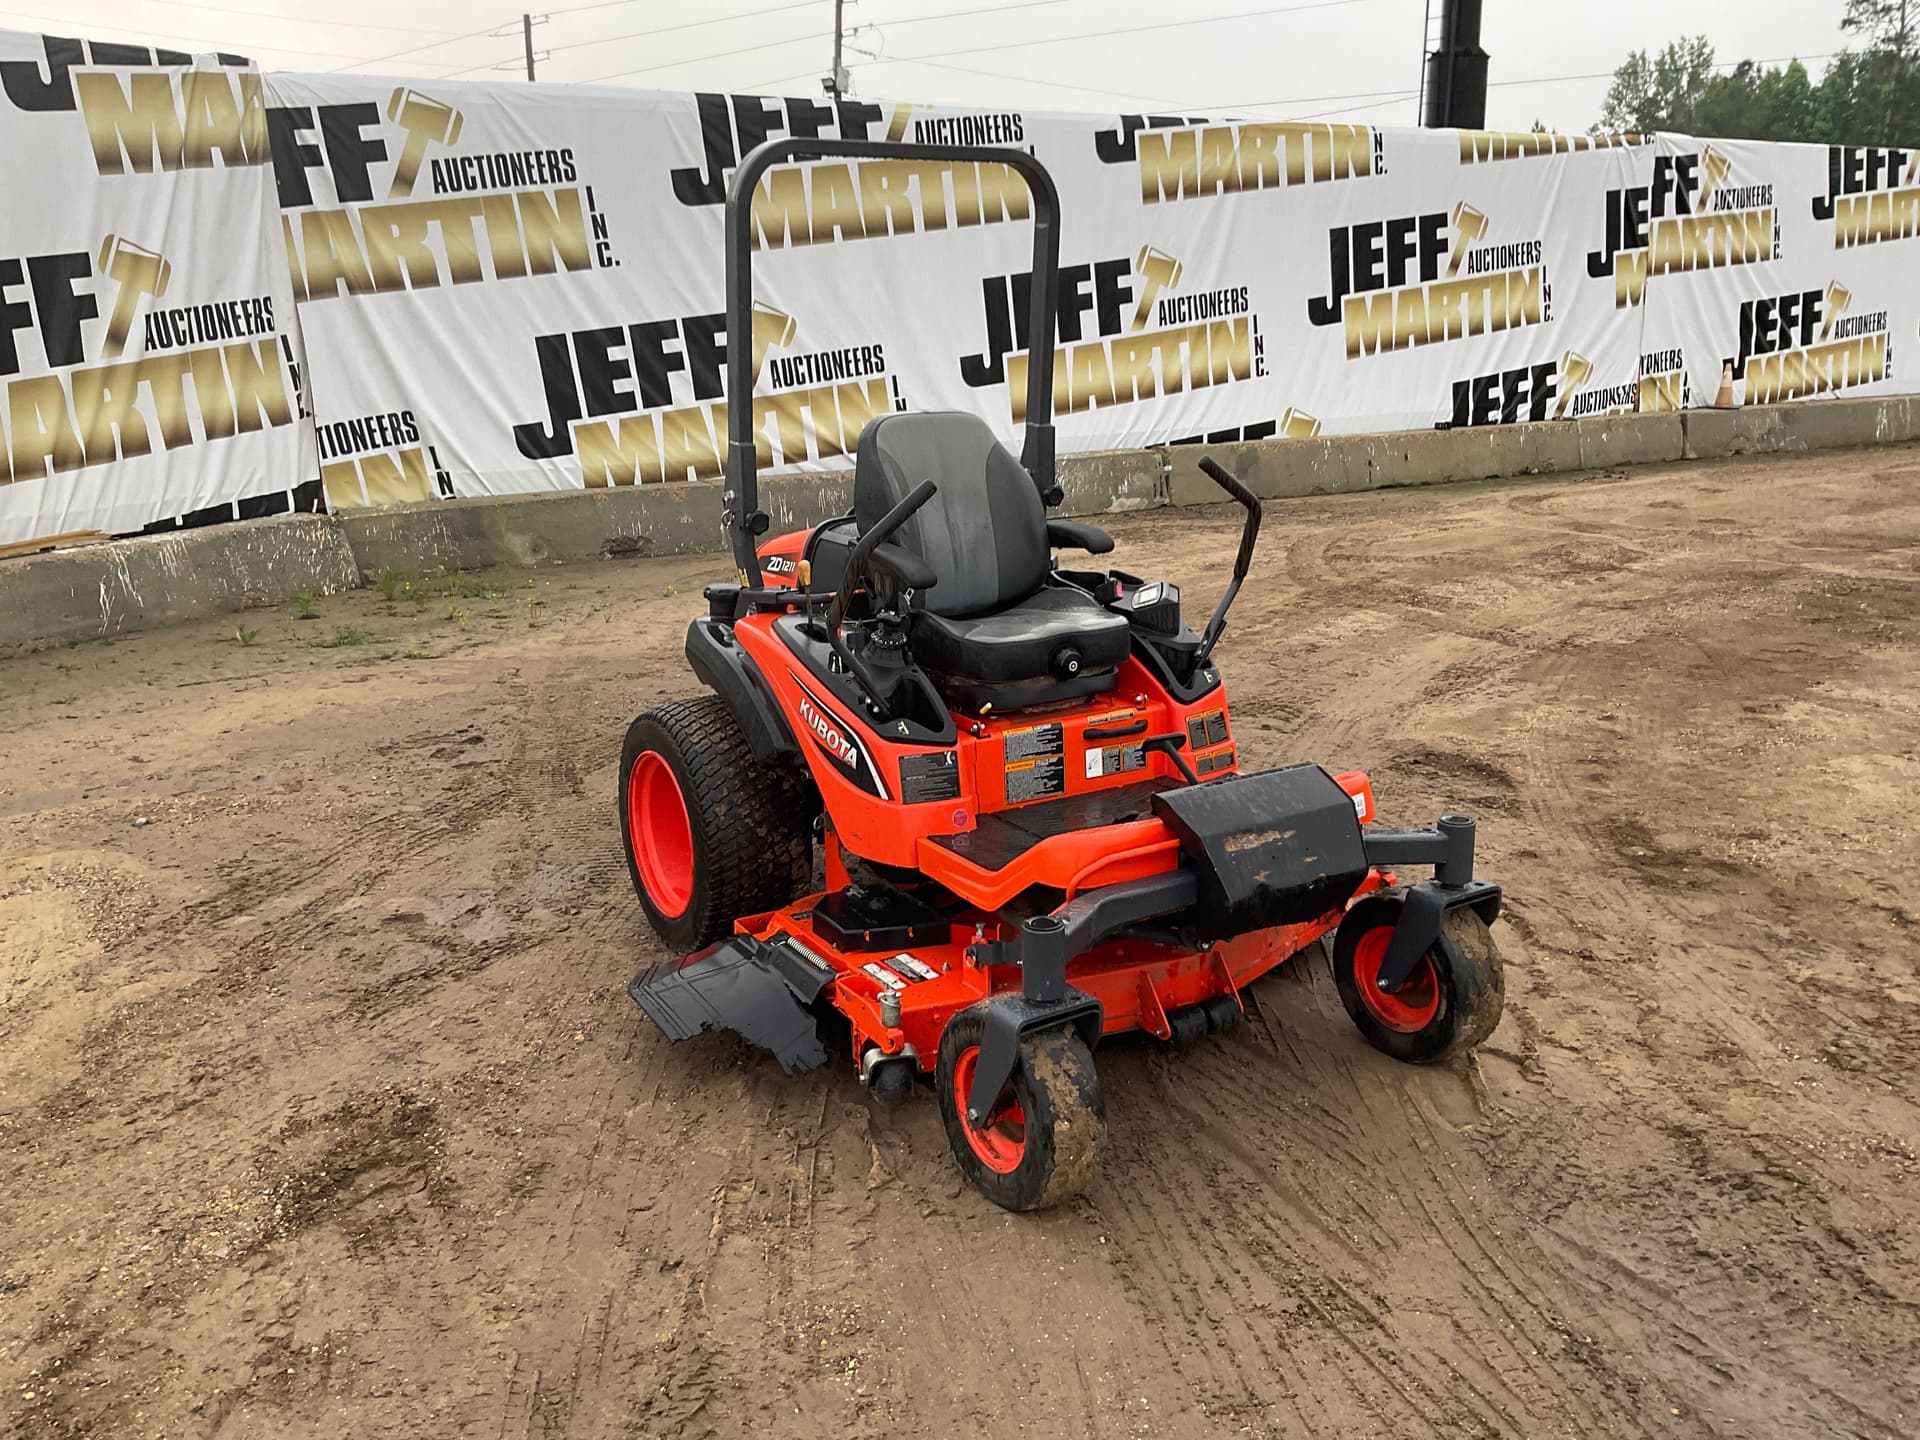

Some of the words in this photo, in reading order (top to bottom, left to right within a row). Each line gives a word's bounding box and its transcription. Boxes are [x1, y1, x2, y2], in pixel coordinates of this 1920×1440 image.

[431, 149, 578, 194] AUCTIONEERS
[1138, 122, 1371, 205] MARTIN
[1714, 184, 1773, 211] AUCTIONEERS
[585, 185, 621, 268] INC.
[1587, 153, 1699, 278] JEFF
[1773, 207, 1783, 260] INC.
[1307, 212, 1449, 326] JEFF
[1467, 240, 1542, 275] AUCTIONEERS
[1542, 265, 1554, 322] INC.
[1616, 209, 1772, 310] MARTIN
[145, 297, 275, 351] AUCTIONEERS
[1159, 286, 1249, 327] AUCTIONEERS
[1343, 267, 1541, 361] MARTIN
[1723, 289, 1824, 381] JEFF
[1834, 311, 1888, 339] AUCTIONEERS
[770, 344, 885, 389] AUCTIONEERS
[1253, 314, 1270, 378] INC.
[1743, 333, 1886, 405] MARTIN
[0, 337, 293, 488] ARTIN
[513, 312, 728, 460] JEFF
[799, 697, 857, 770] KUBOTA
